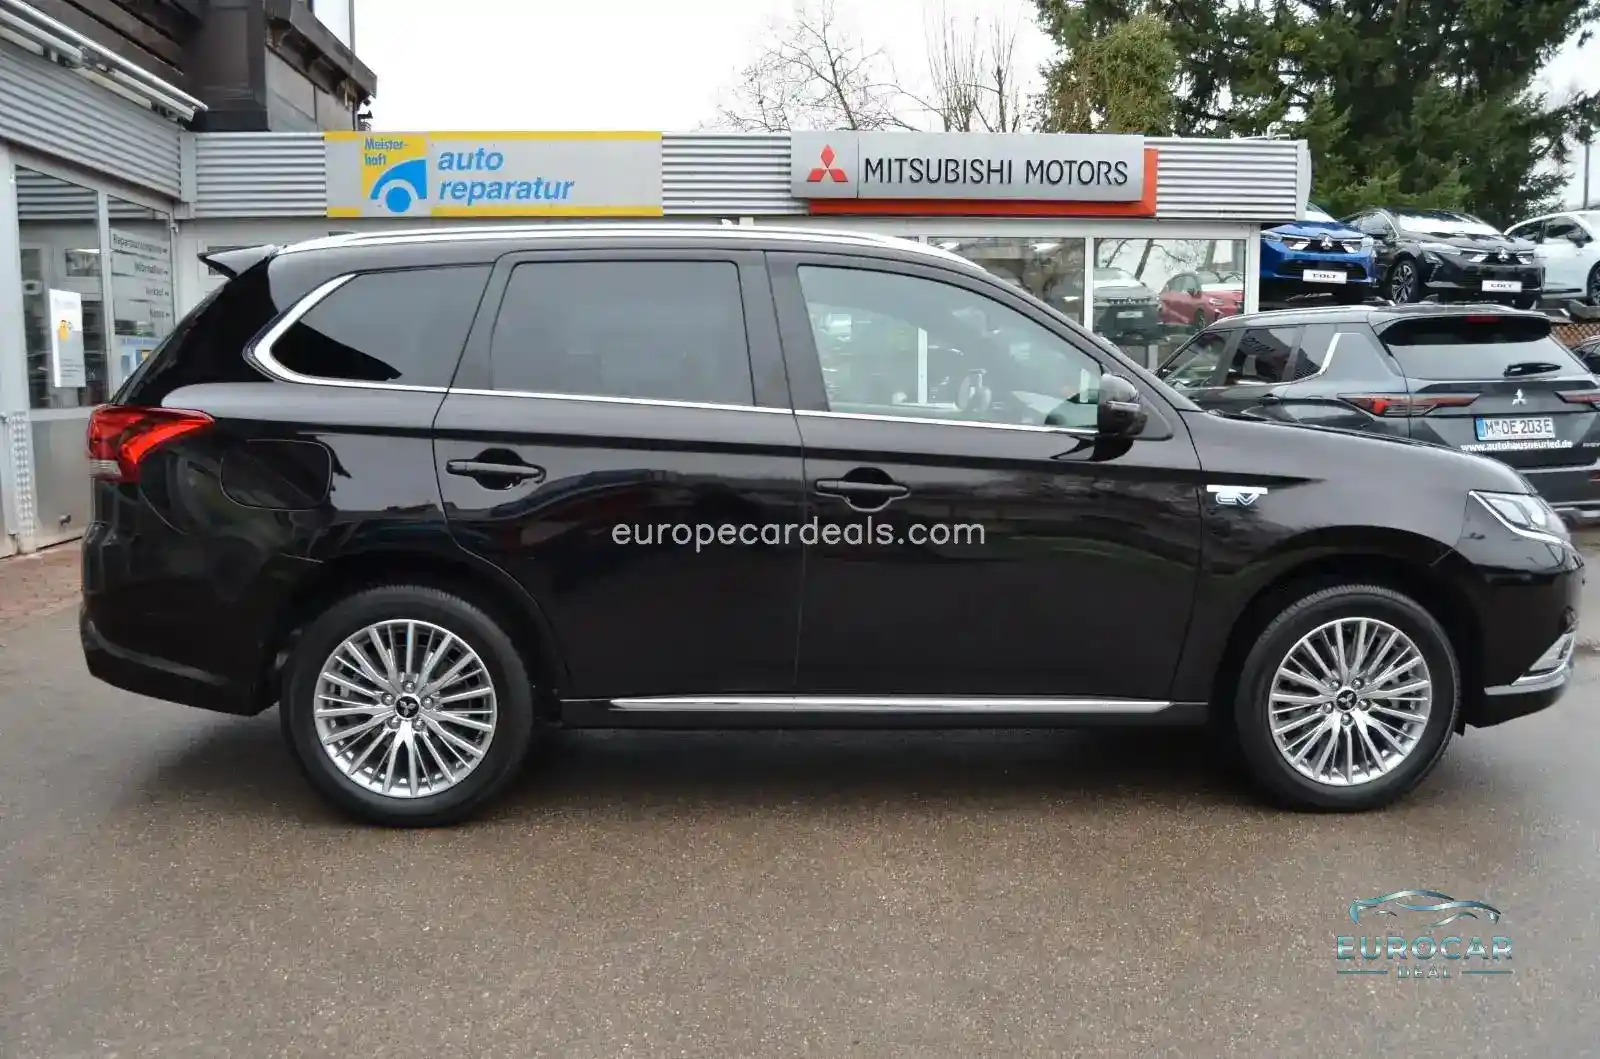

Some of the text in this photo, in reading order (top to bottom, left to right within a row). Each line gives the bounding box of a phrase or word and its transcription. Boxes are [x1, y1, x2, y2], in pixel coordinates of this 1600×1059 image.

[364, 138, 409, 150] Meister-
[364, 153, 387, 166] haft
[438, 147, 504, 170] auto
[864, 157, 1129, 186] MITSUBISHI MOTORS
[438, 176, 574, 205] reparatur
[1485, 421, 1495, 434] M
[1460, 440, 1573, 451] www.autohausneuried.de
